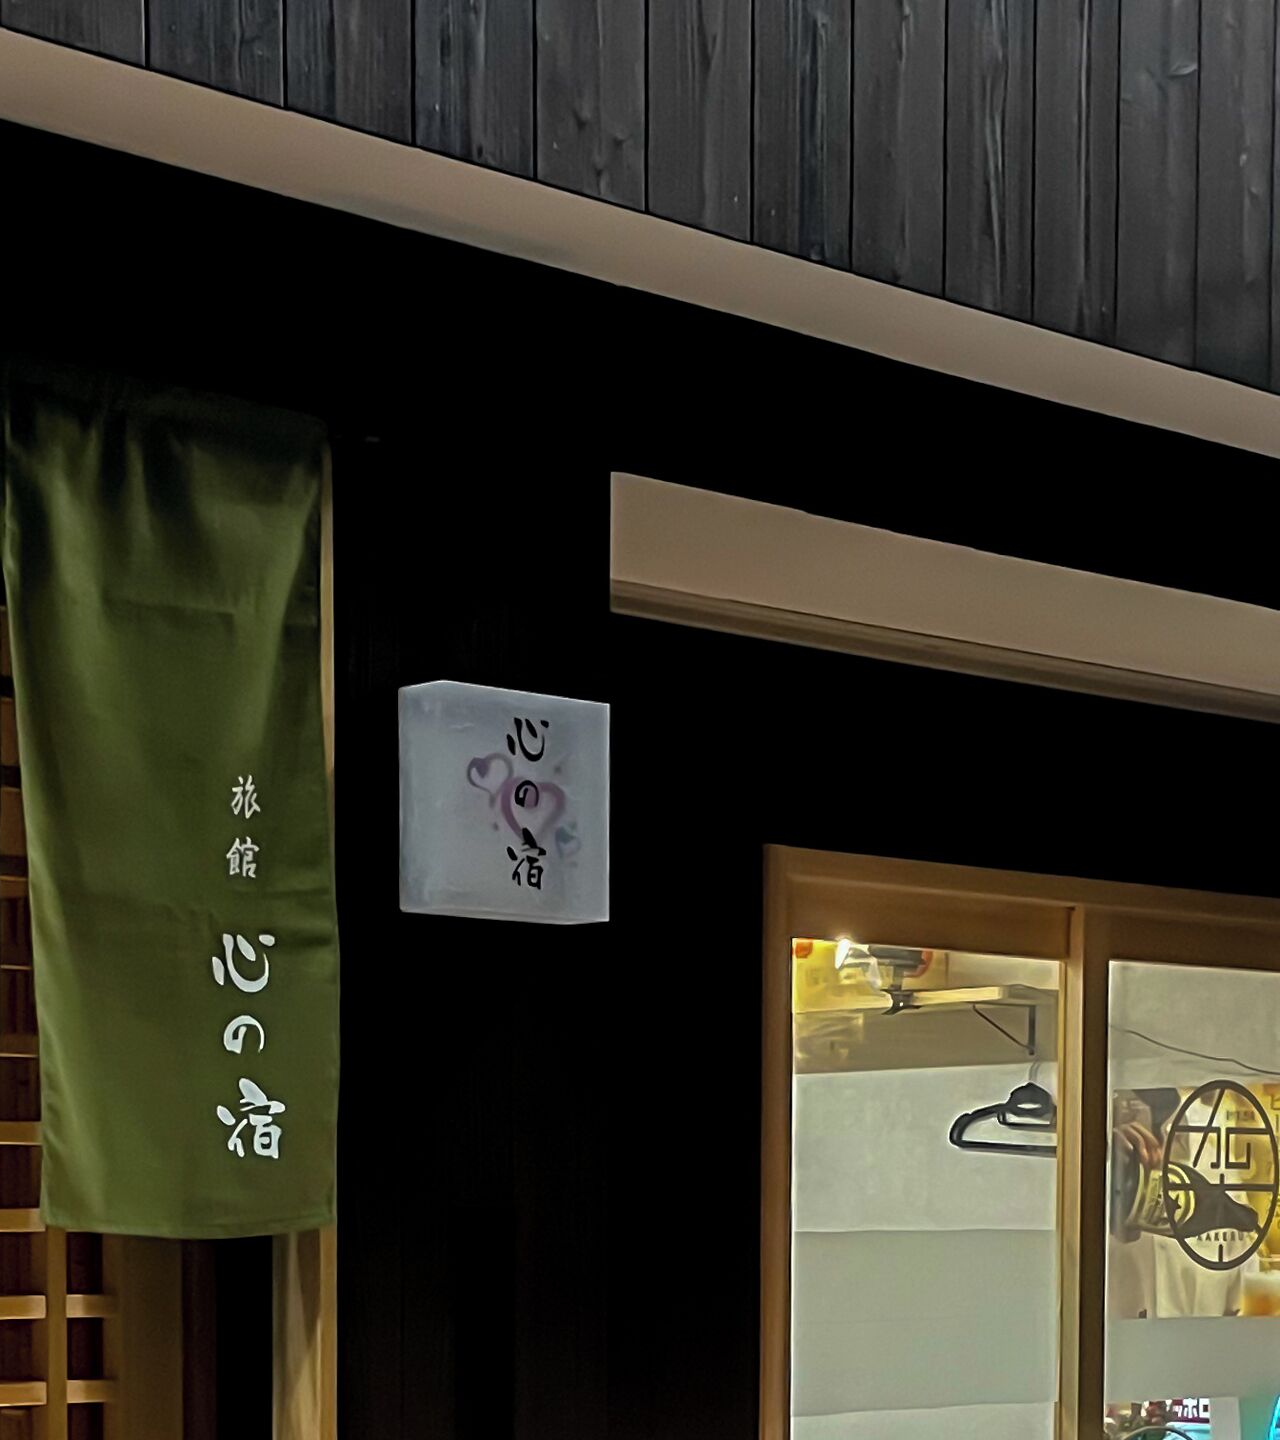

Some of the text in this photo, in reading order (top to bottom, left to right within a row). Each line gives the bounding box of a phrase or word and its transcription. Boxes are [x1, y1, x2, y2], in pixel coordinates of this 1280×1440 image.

[226, 775, 261, 878] 旅館
[507, 717, 549, 889] 心の宿
[212, 934, 285, 1159] 心の宿
